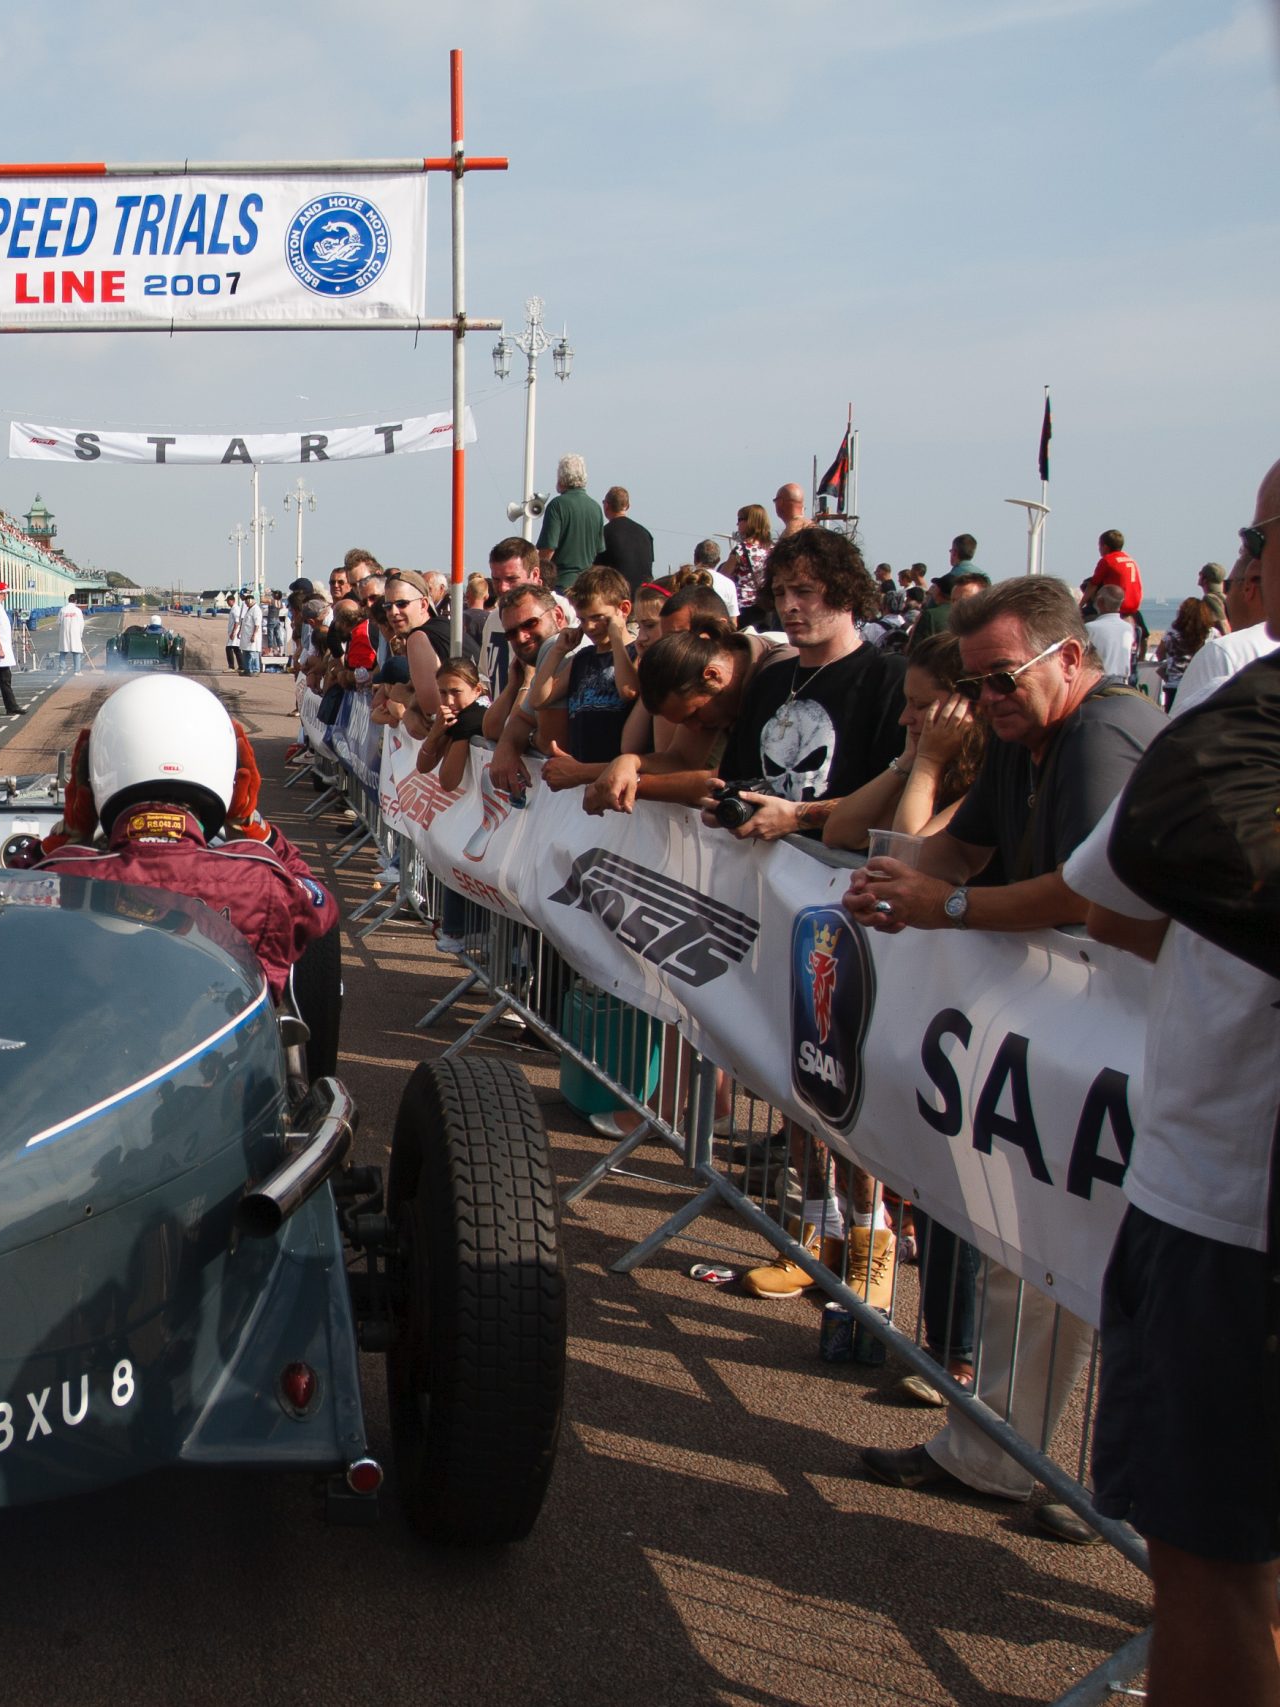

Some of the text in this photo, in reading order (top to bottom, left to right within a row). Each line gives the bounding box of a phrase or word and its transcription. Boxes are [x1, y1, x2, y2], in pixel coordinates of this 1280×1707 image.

[113, 193, 263, 256] TRIALS
[290, 198, 387, 288] BRIGHTON AND HOVE MOTOR CLUB
[15, 271, 125, 305] LINE
[144, 272, 241, 296] 2007
[1125, 562, 1136, 583] 7
[452, 867, 508, 912] SEAT
[798, 1041, 846, 1095] SAAB
[111, 1358, 135, 1407] 8
